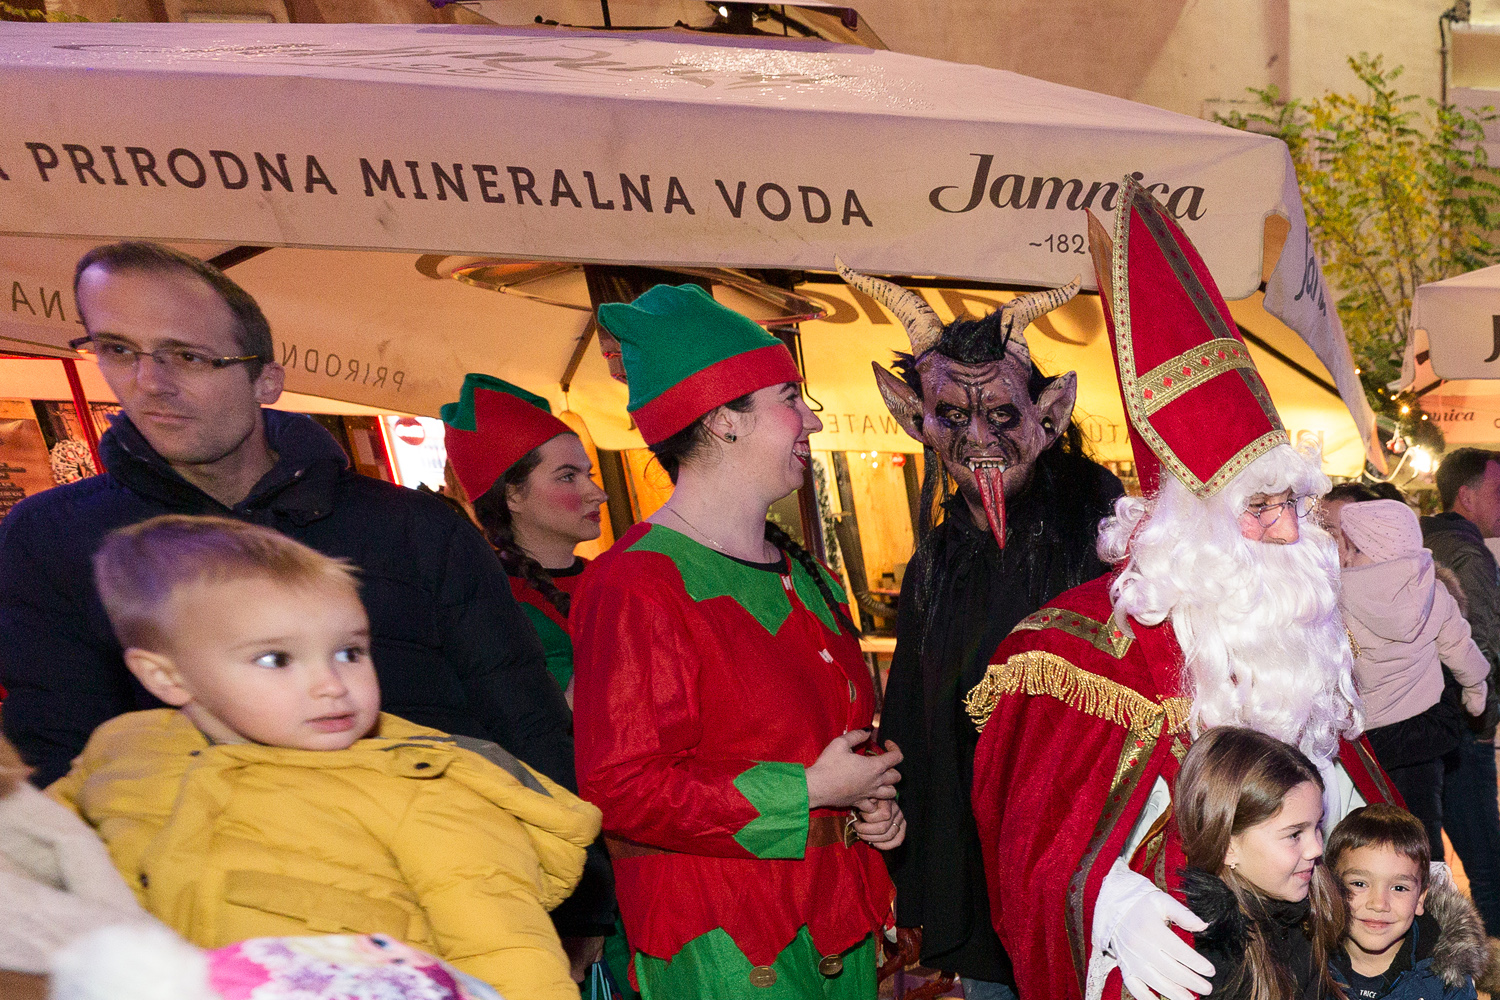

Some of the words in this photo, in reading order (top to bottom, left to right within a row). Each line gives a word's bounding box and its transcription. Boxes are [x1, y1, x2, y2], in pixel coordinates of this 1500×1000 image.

[25, 141, 338, 195] PRIRODNA
[359, 157, 696, 216] MINERALNA
[715, 179, 874, 228] VODA
[928, 153, 1208, 221] Jamnca
